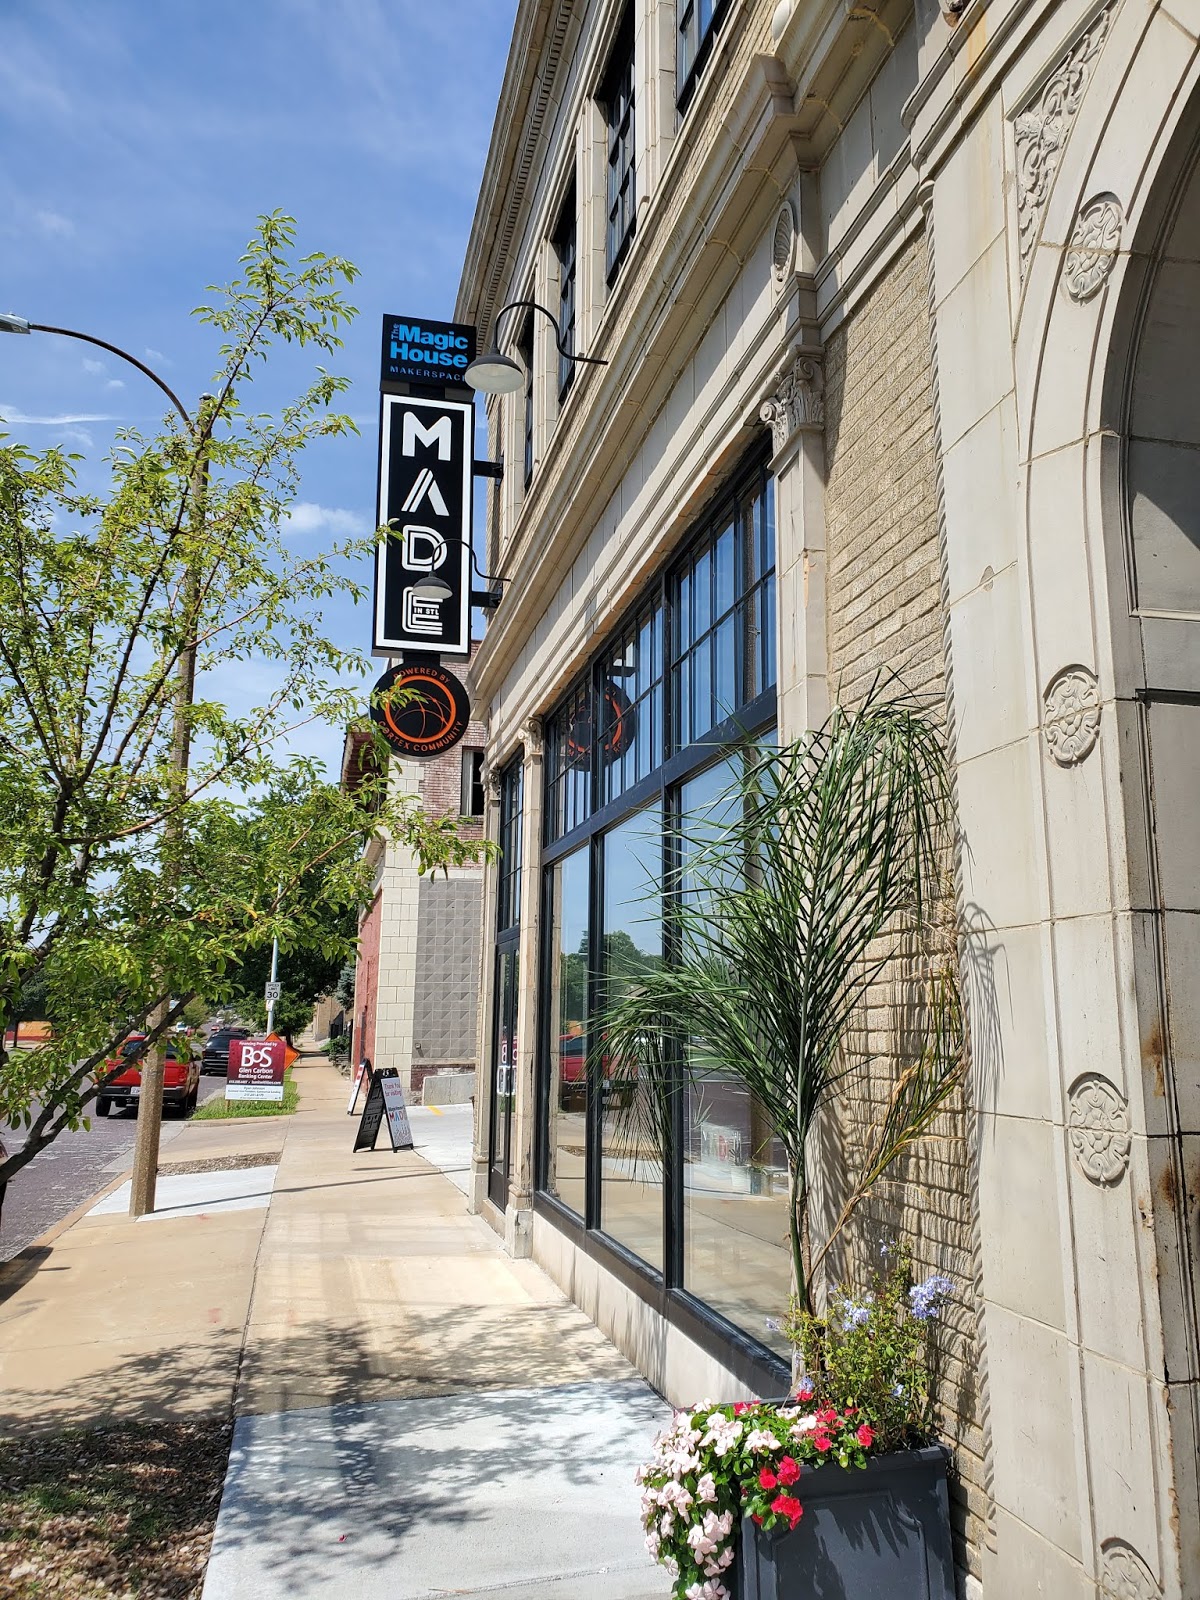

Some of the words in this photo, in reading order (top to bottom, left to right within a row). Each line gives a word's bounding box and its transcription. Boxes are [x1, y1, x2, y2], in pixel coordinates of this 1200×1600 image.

[391, 323, 400, 339] The
[399, 324, 468, 349] Magic
[390, 341, 468, 368] House
[426, 608, 440, 616] STL
[393, 667, 438, 679] POWERED
[439, 673, 451, 684] BY
[378, 720, 410, 750] CORTEX
[413, 721, 463, 752] COMMUNITY
[266, 991, 279, 999] 30
[389, 1110, 408, 1123] MAD
